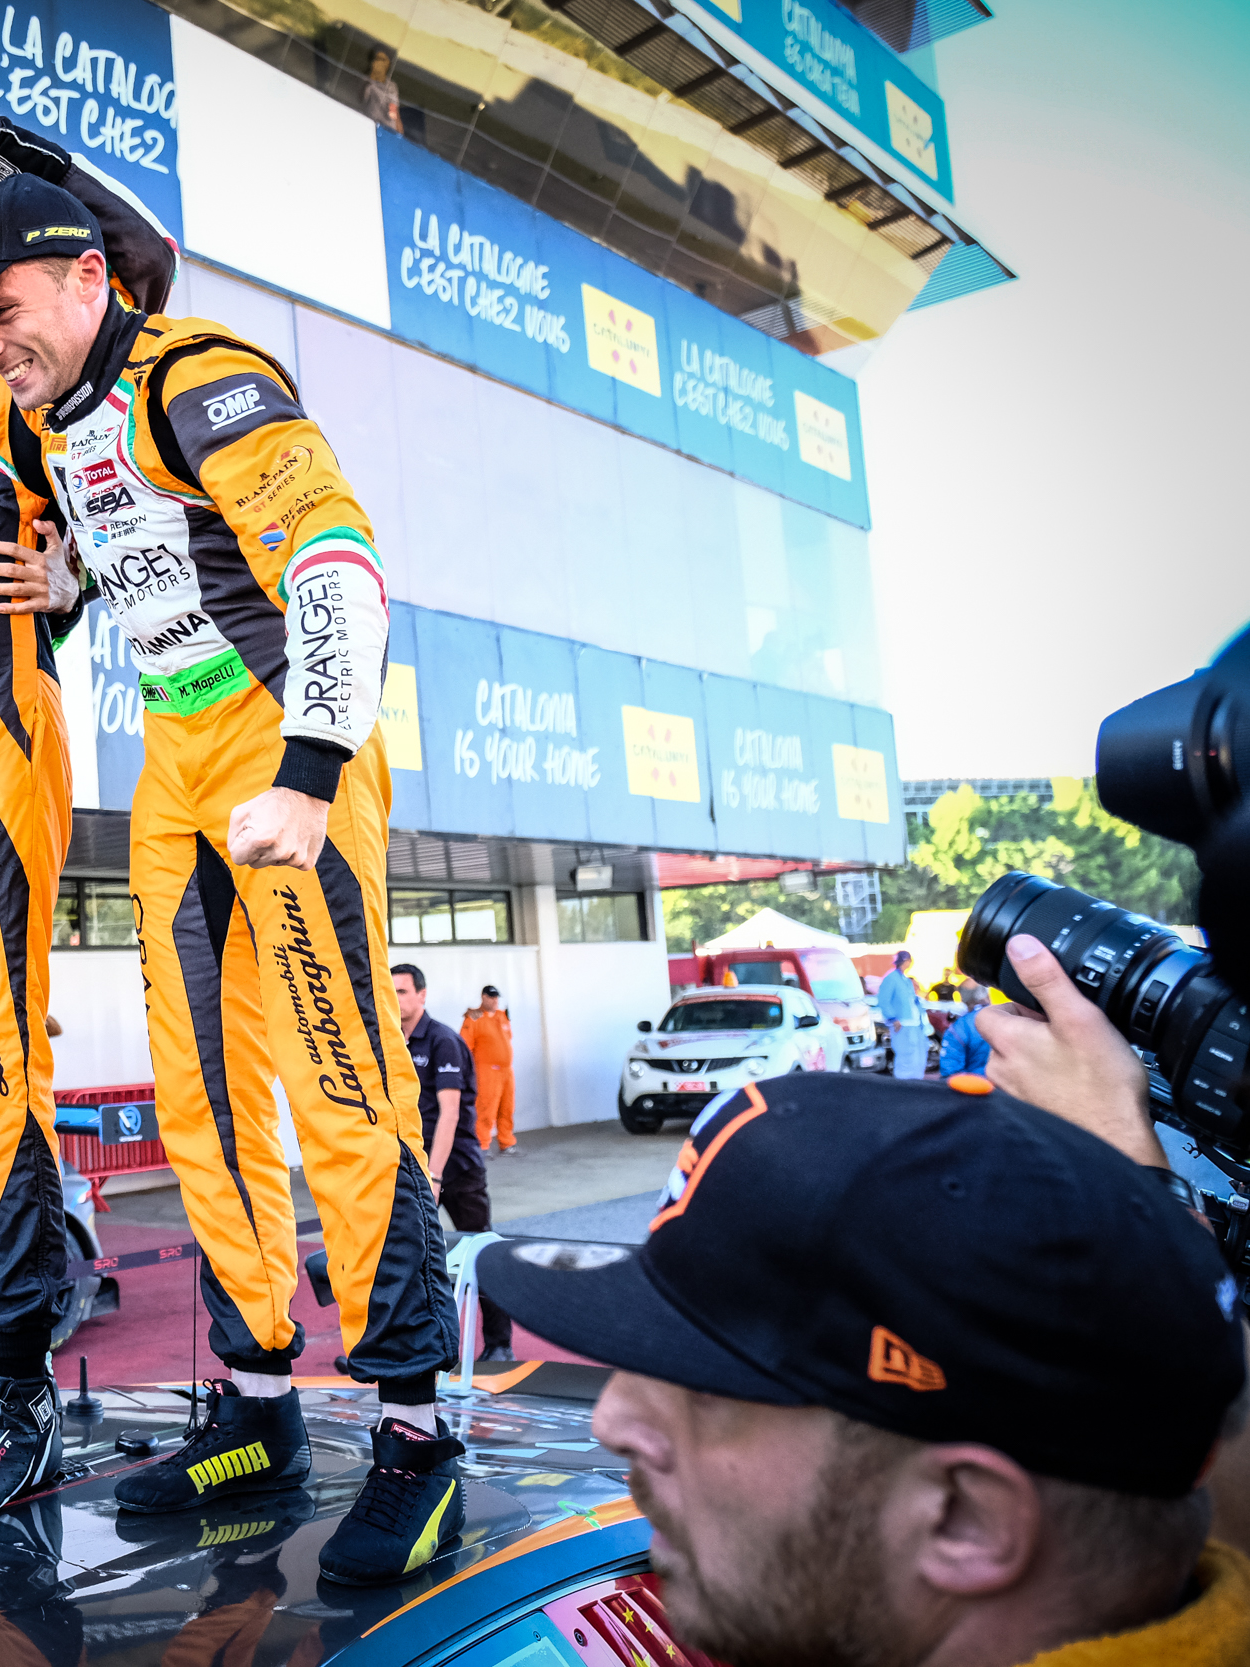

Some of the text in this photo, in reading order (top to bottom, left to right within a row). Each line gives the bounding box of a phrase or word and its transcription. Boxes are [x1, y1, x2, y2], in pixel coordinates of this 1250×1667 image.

[2, 5, 43, 68] LA
[26, 230, 41, 243] P
[413, 208, 440, 257] LA
[524, 304, 570, 353] VOUS
[207, 388, 261, 424] OMP
[86, 466, 115, 482] TOTAL
[235, 456, 299, 509] BLANCPAIN
[253, 474, 296, 513] GT SERIES
[280, 484, 335, 525] REAFON
[125, 567, 191, 609] MOTORS
[326, 570, 350, 640] MOTORS
[178, 664, 236, 699] M. Mapelli
[475, 678, 577, 738] CATALONIA
[454, 728, 601, 791] IS YOUR HOME
[272, 943, 323, 1065] automobili
[273, 885, 378, 1126] Lamborghini
[94, 1257, 119, 1270] SRO
[159, 1246, 183, 1259] SRO
[187, 1441, 271, 1495] PUMA
